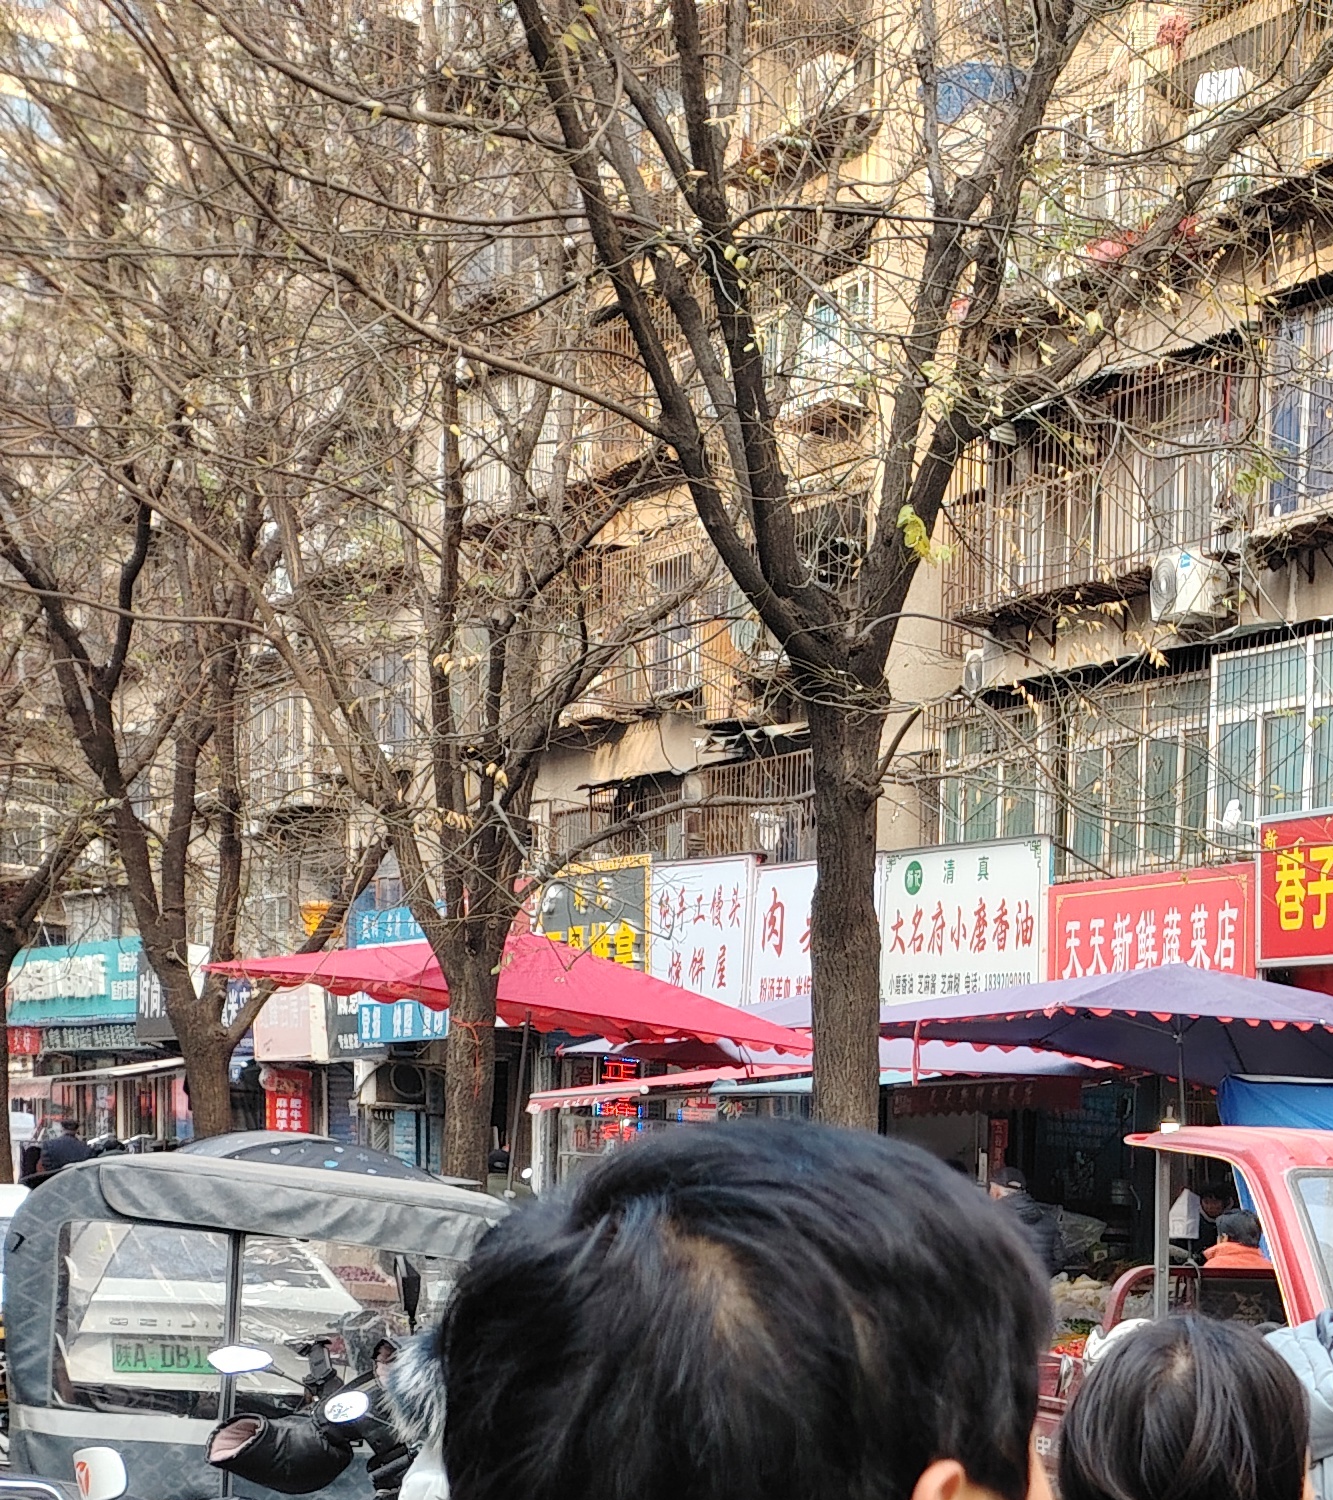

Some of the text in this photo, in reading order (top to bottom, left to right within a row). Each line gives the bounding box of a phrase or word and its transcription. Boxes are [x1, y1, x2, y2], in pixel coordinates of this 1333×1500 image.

[943, 857, 990, 884] 清真
[658, 882, 741, 933] 纯手工馒头
[889, 897, 1034, 957] 大名府小磨香油
[1061, 900, 1239, 980] 天天新鲜蔬菜店
[668, 944, 726, 993] 烧饼屋
[139, 969, 167, 1019] 时尚
